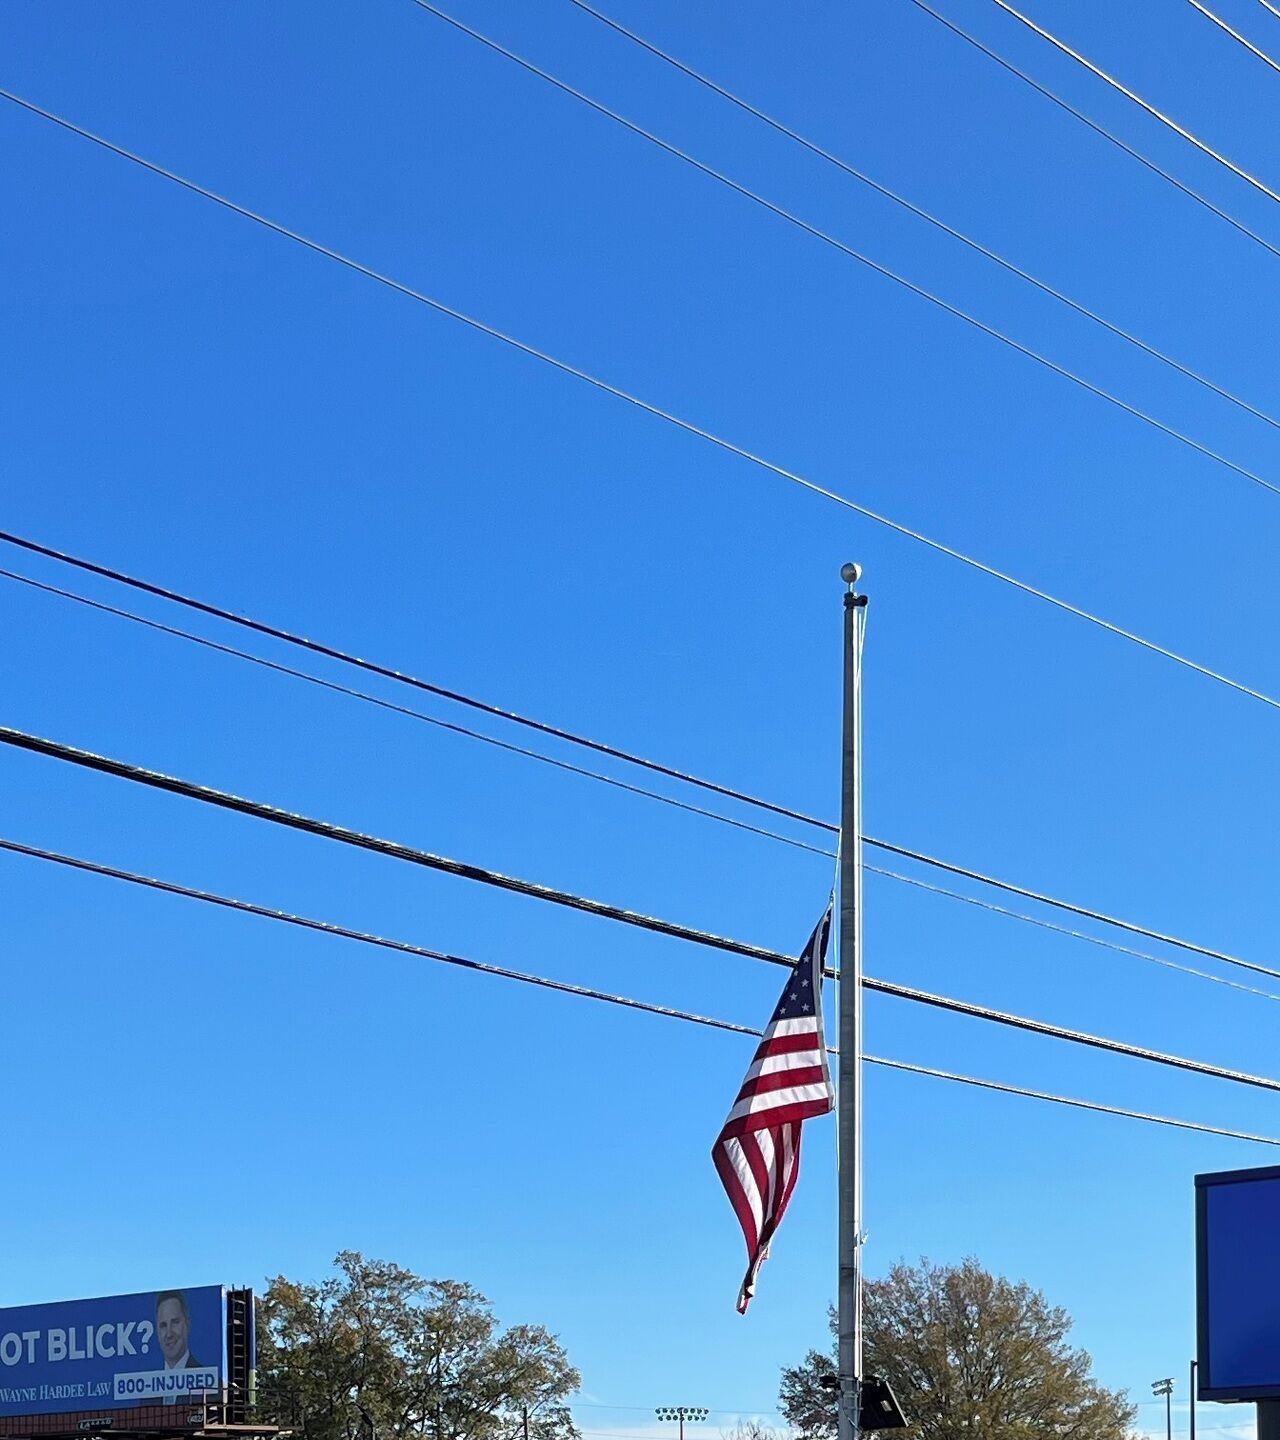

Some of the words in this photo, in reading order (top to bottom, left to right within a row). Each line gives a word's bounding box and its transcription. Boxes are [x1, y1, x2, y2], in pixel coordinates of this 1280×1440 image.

[47, 1319, 154, 1362] BLICK?
[87, 1381, 112, 1397] LAW
[118, 1373, 215, 1394] 800-INJURED
